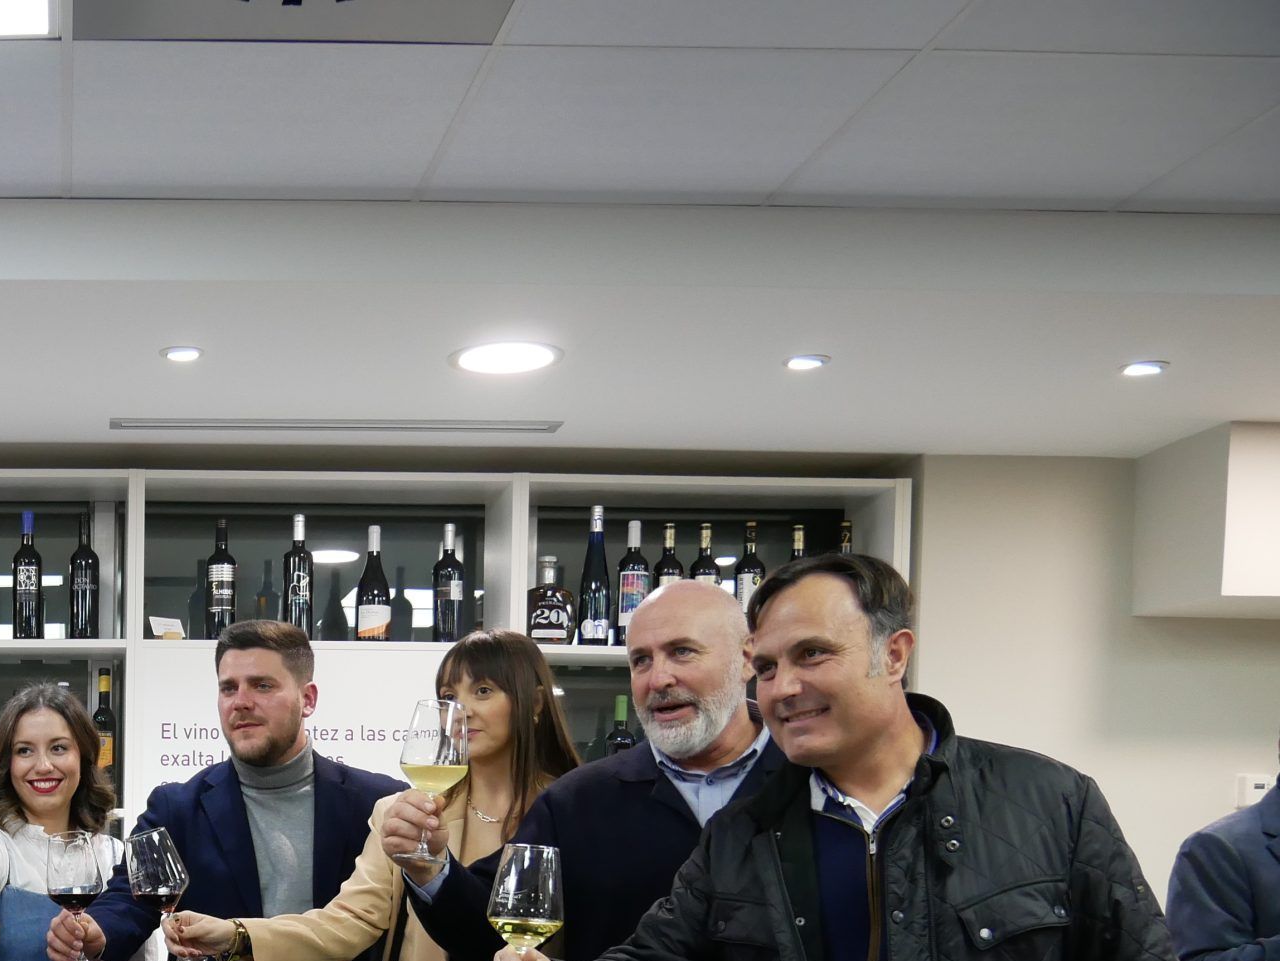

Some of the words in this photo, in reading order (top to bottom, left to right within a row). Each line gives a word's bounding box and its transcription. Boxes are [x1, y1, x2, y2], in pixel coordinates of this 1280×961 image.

[535, 608, 564, 624] 20
[161, 722, 178, 740] El
[183, 722, 220, 740] vino
[345, 728, 354, 741] a
[361, 725, 386, 742] las
[160, 750, 215, 767] exalta
